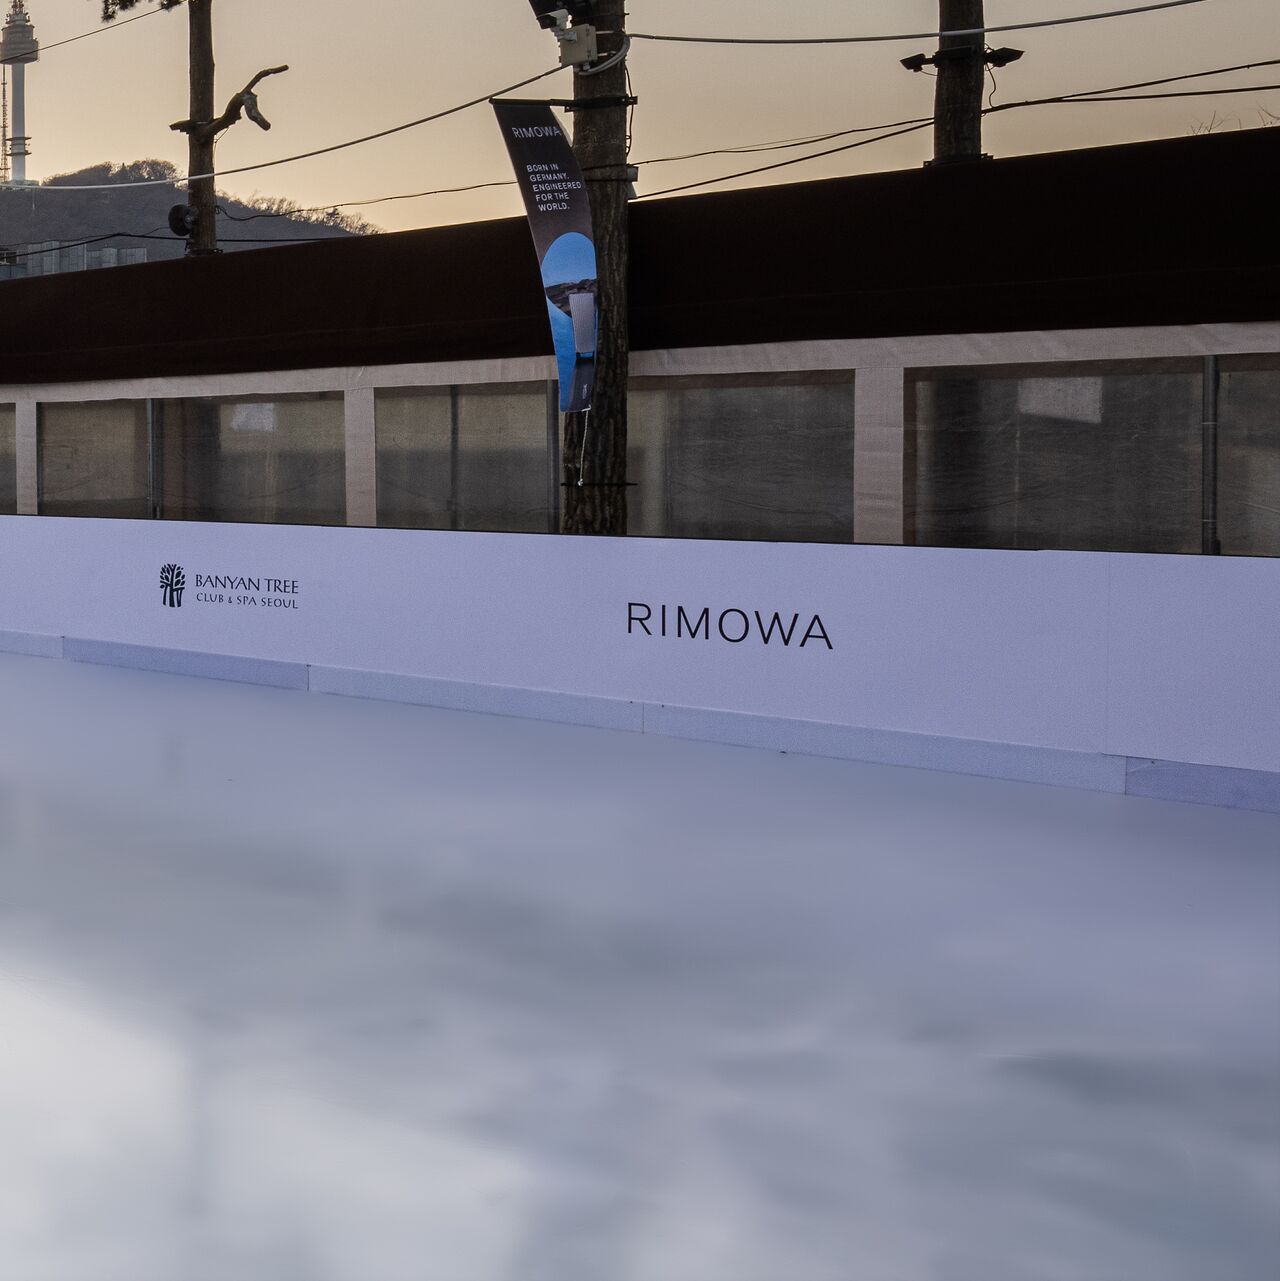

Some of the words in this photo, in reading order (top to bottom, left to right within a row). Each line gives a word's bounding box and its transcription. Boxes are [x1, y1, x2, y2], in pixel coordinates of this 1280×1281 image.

[512, 126, 561, 138] RIMOWA
[526, 163, 549, 173] BORN
[529, 172, 570, 182] GERMANY.
[532, 181, 582, 192] ENGINEERED
[555, 191, 570, 200] THE
[538, 202, 571, 211] WORLD.
[195, 574, 261, 592] BANYAN
[263, 578, 300, 594] TREE
[196, 592, 224, 603] CLUB
[236, 595, 257, 606] SPA
[260, 597, 299, 609] SEOUL
[627, 602, 834, 650] RIMOWA
